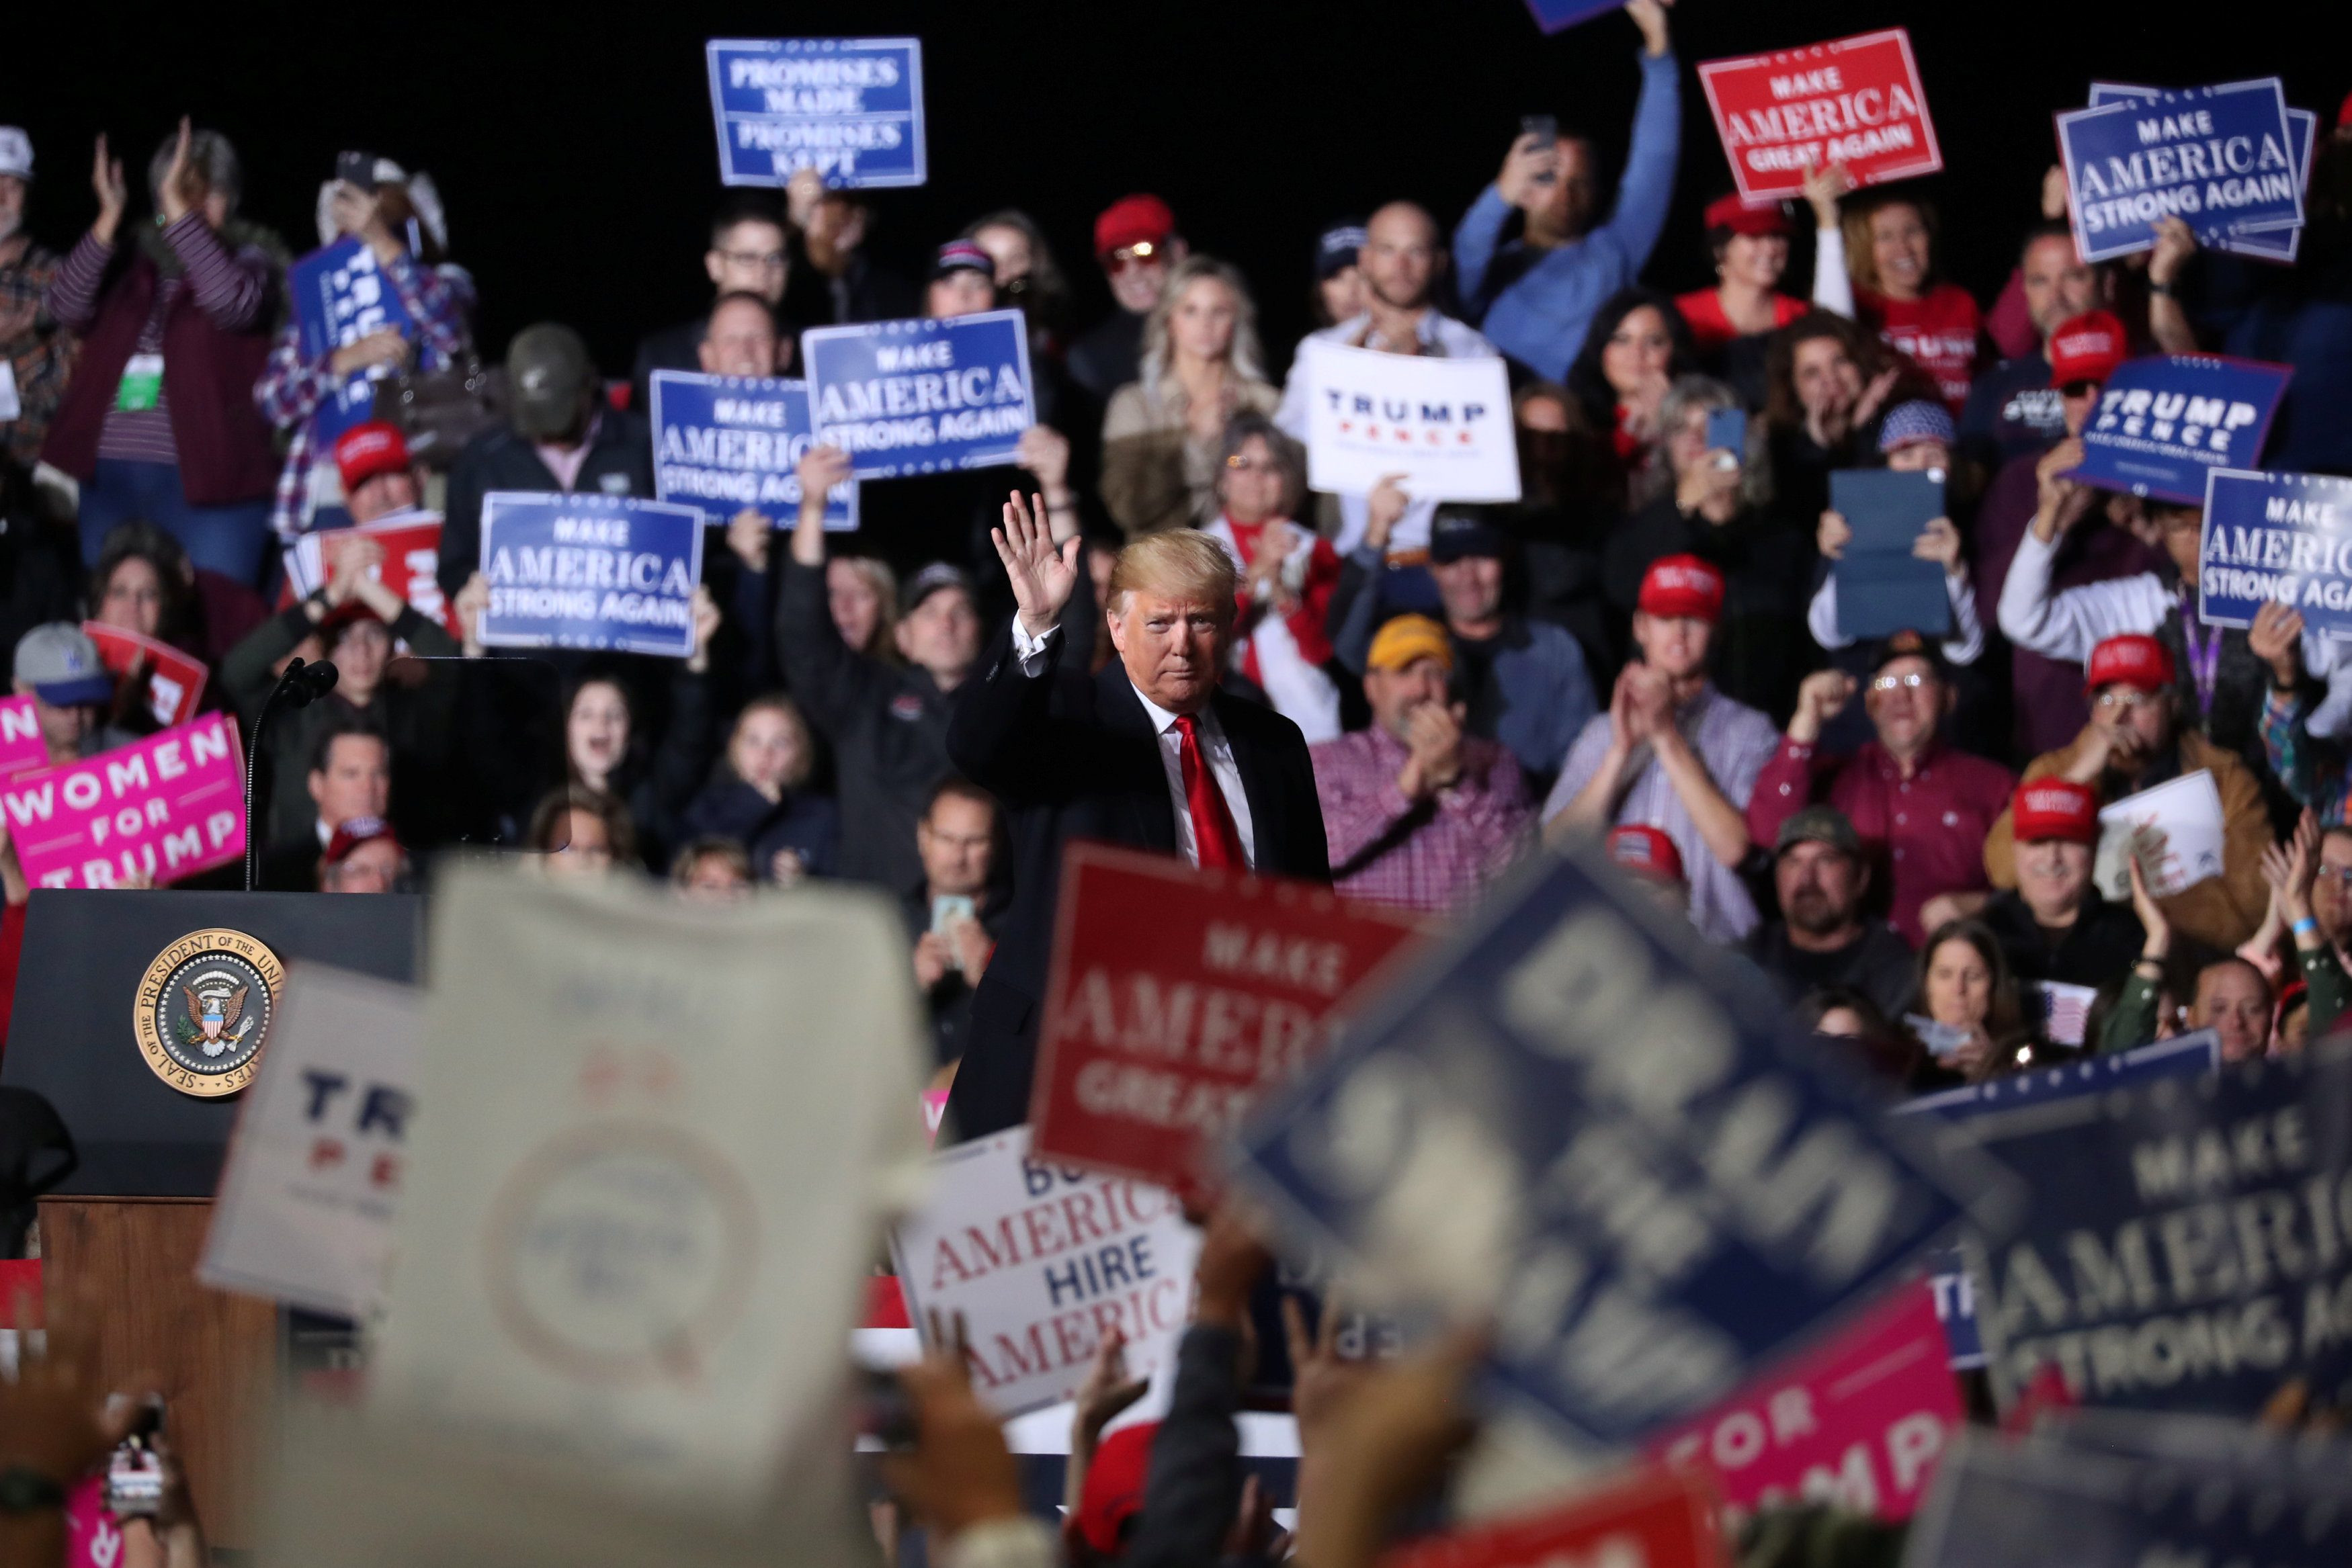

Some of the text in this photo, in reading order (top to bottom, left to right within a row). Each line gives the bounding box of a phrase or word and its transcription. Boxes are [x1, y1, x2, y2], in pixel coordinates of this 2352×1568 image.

[729, 56, 899, 89] PROMISES
[1769, 66, 1843, 100] MAKE
[737, 120, 902, 150] PROMISES
[1726, 83, 1918, 146] AMERICA
[2136, 110, 2214, 145] MAKE
[1747, 123, 1914, 173] GREAT AGAIN
[2080, 132, 2290, 201] AMERICA
[2084, 172, 2293, 233] STRONG AGAIN
[876, 340, 954, 373] MAKE
[714, 398, 787, 427] MAKE
[819, 362, 1024, 423] AMERICA
[1325, 388, 1486, 424] TRUMP
[2101, 389, 2257, 431] TRUMP
[659, 423, 812, 473] AMERIC
[819, 404, 1027, 453] STRONG AGAIN
[2095, 413, 2232, 451] PENCE
[661, 464, 758, 504] STRONG
[553, 516, 630, 546] MAKE
[2266, 496, 2335, 528] MAKE
[489, 545, 691, 597] AMERICA
[2206, 524, 2352, 578] AMERIC
[489, 586, 597, 620] STRONG
[599, 591, 687, 628] AGAIN
[2203, 566, 2352, 611] STRONG AGA
[4, 722, 229, 827] WOMEN
[91, 797, 169, 846] FOR
[40, 810, 236, 889] TRUMP
[218, 936, 233, 947] OF
[235, 939, 255, 956] THE
[1204, 921, 1344, 998] MAKE
[140, 934, 214, 1009] PRESIDENT
[257, 955, 285, 994] UNI
[142, 1014, 153, 1039] THE
[147, 1041, 159, 1055] OF
[1058, 965, 1320, 1086] AMER
[157, 1053, 197, 1088] SEAL
[2132, 1105, 2303, 1203] MAKE
[932, 1177, 1181, 1291] AMERIC
[1994, 1172, 2352, 1329] AMERI
[1045, 1234, 1157, 1311] HIRE
[961, 1272, 1203, 1388] AMERIC
